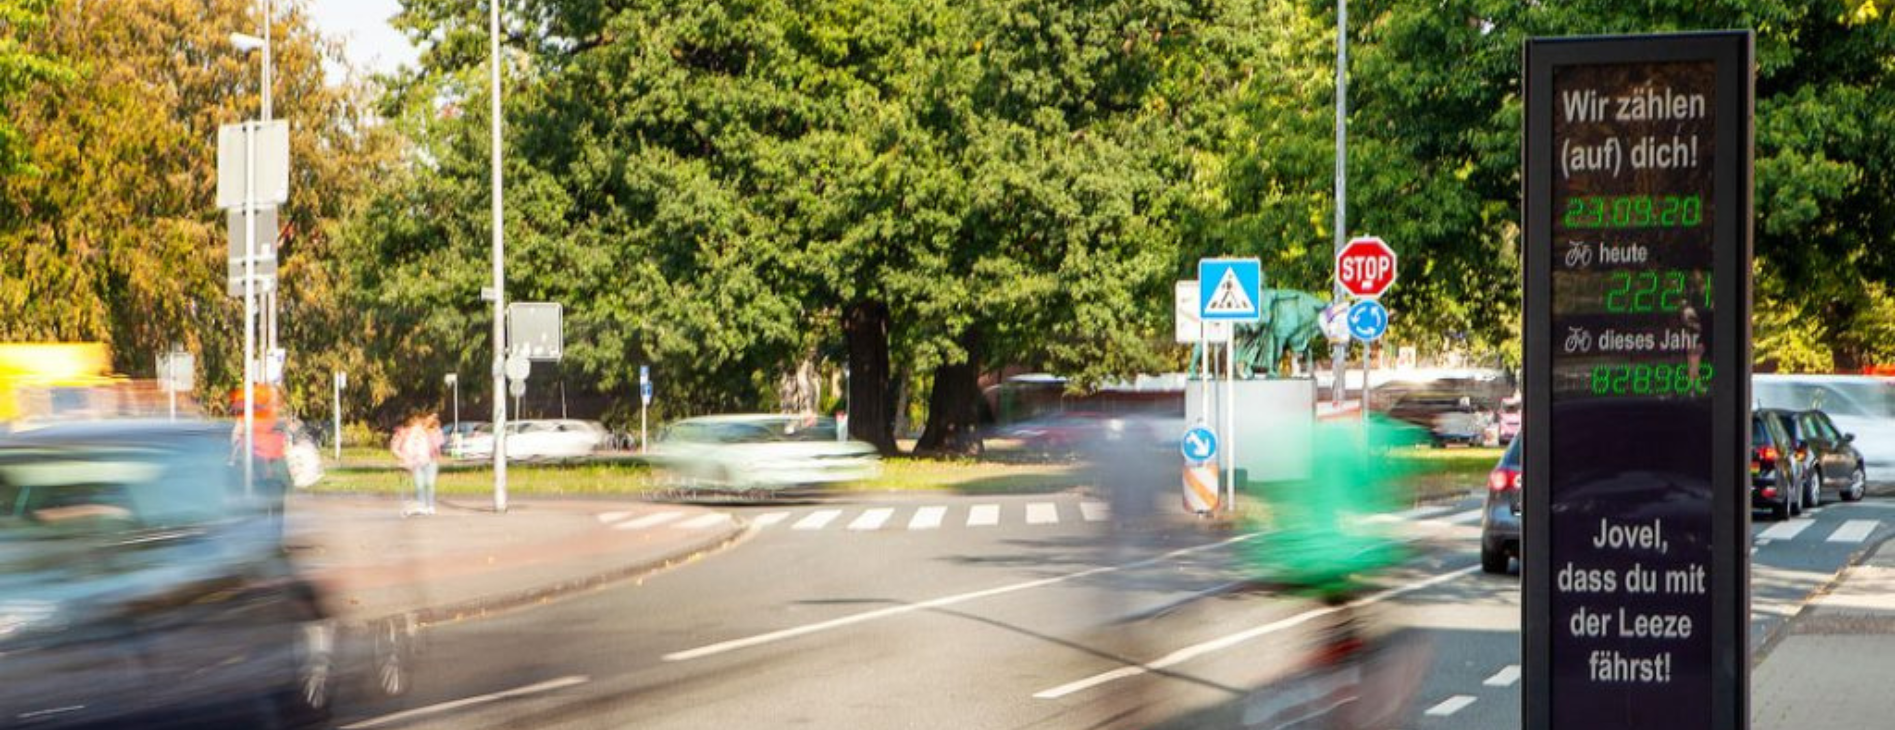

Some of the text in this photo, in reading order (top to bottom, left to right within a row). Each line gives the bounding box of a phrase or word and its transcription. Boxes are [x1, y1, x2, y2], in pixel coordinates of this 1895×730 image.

[1562, 87, 1705, 123] Wir zählen
[1561, 135, 1699, 179] (auf) dich!
[1564, 195, 1702, 228] 23.09.20
[1343, 256, 1390, 281] STOP
[1599, 242, 1648, 263] heute
[1598, 329, 1699, 350] dieses Jahr
[1593, 517, 1669, 554] Jovel,
[1557, 562, 1706, 594] dass du mit
[1569, 606, 1693, 637] der Leeze
[1589, 651, 1672, 683] fährst!
